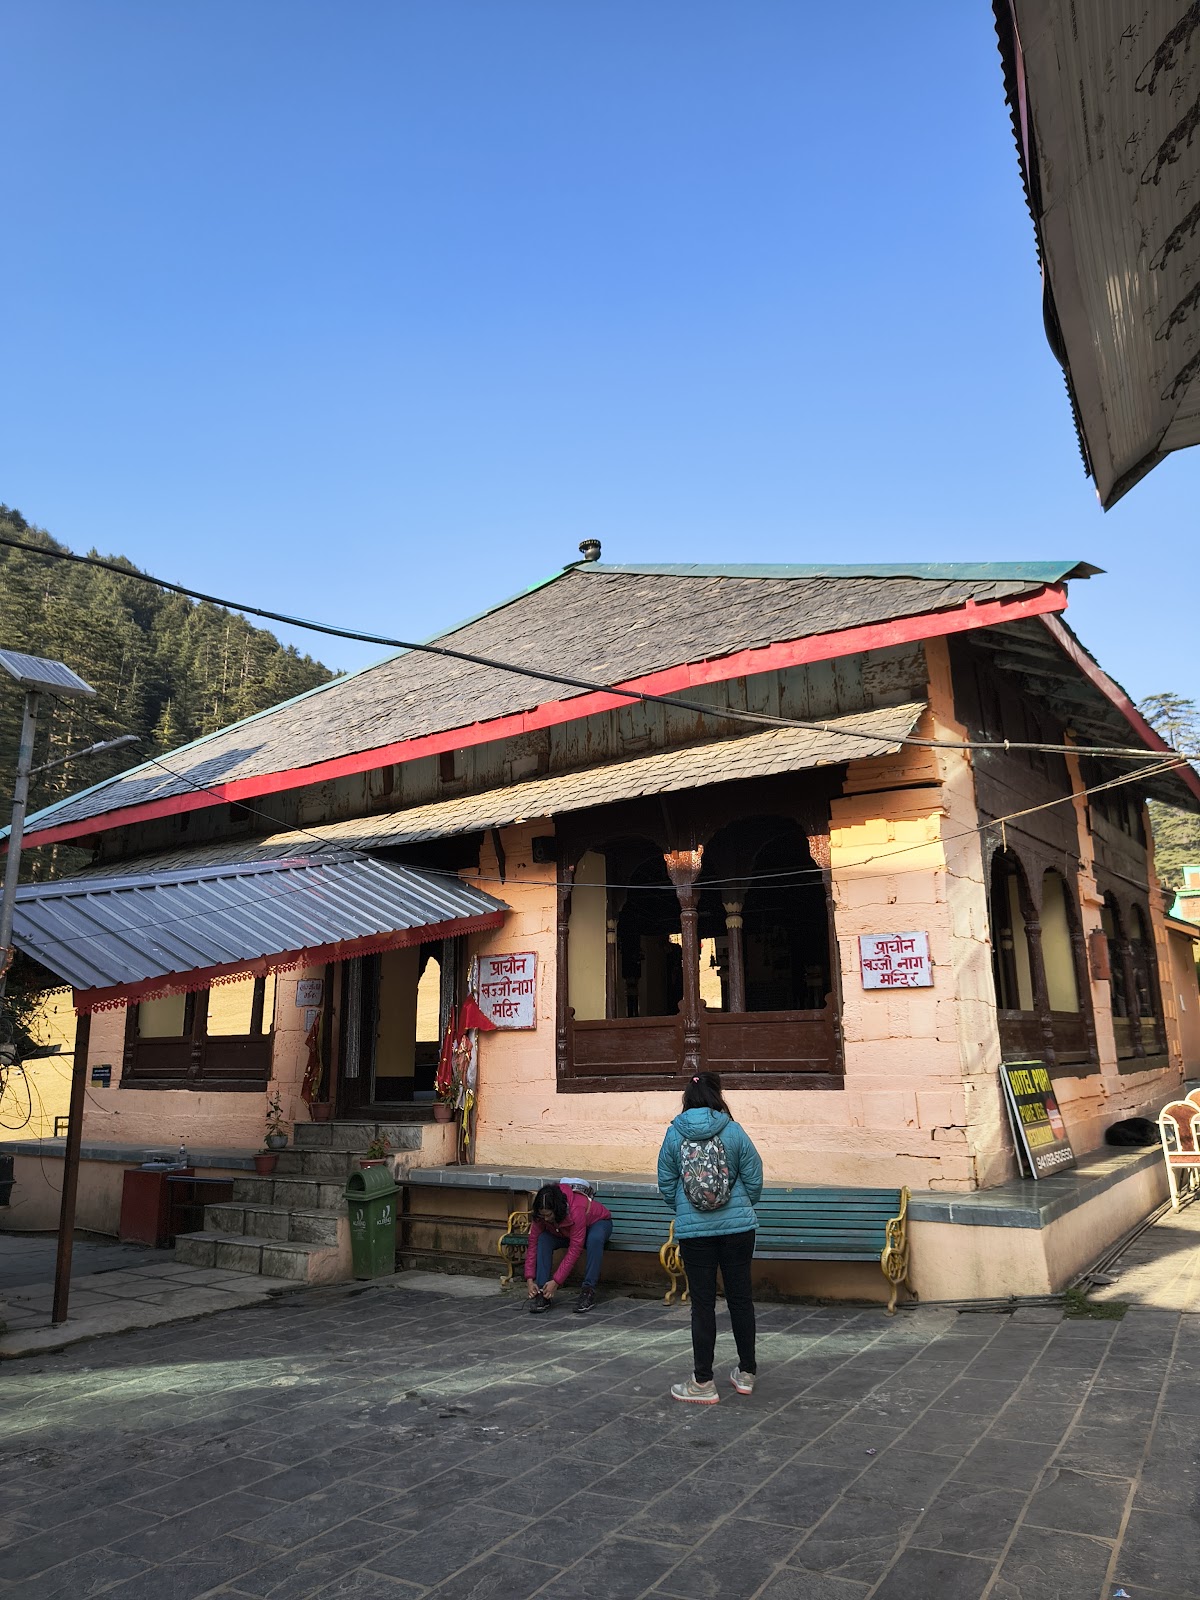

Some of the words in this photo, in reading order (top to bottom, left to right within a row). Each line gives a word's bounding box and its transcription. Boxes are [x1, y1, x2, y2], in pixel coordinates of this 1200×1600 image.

[874, 935, 916, 955] प्राचीन
[489, 956, 527, 976] प्राचीन
[897, 956, 924, 970] नाग
[880, 969, 919, 987] मन्दिर
[492, 998, 521, 1019] मंदिर
[1008, 1069, 1036, 1096] HOTEL
[1031, 1067, 1053, 1092] PURI
